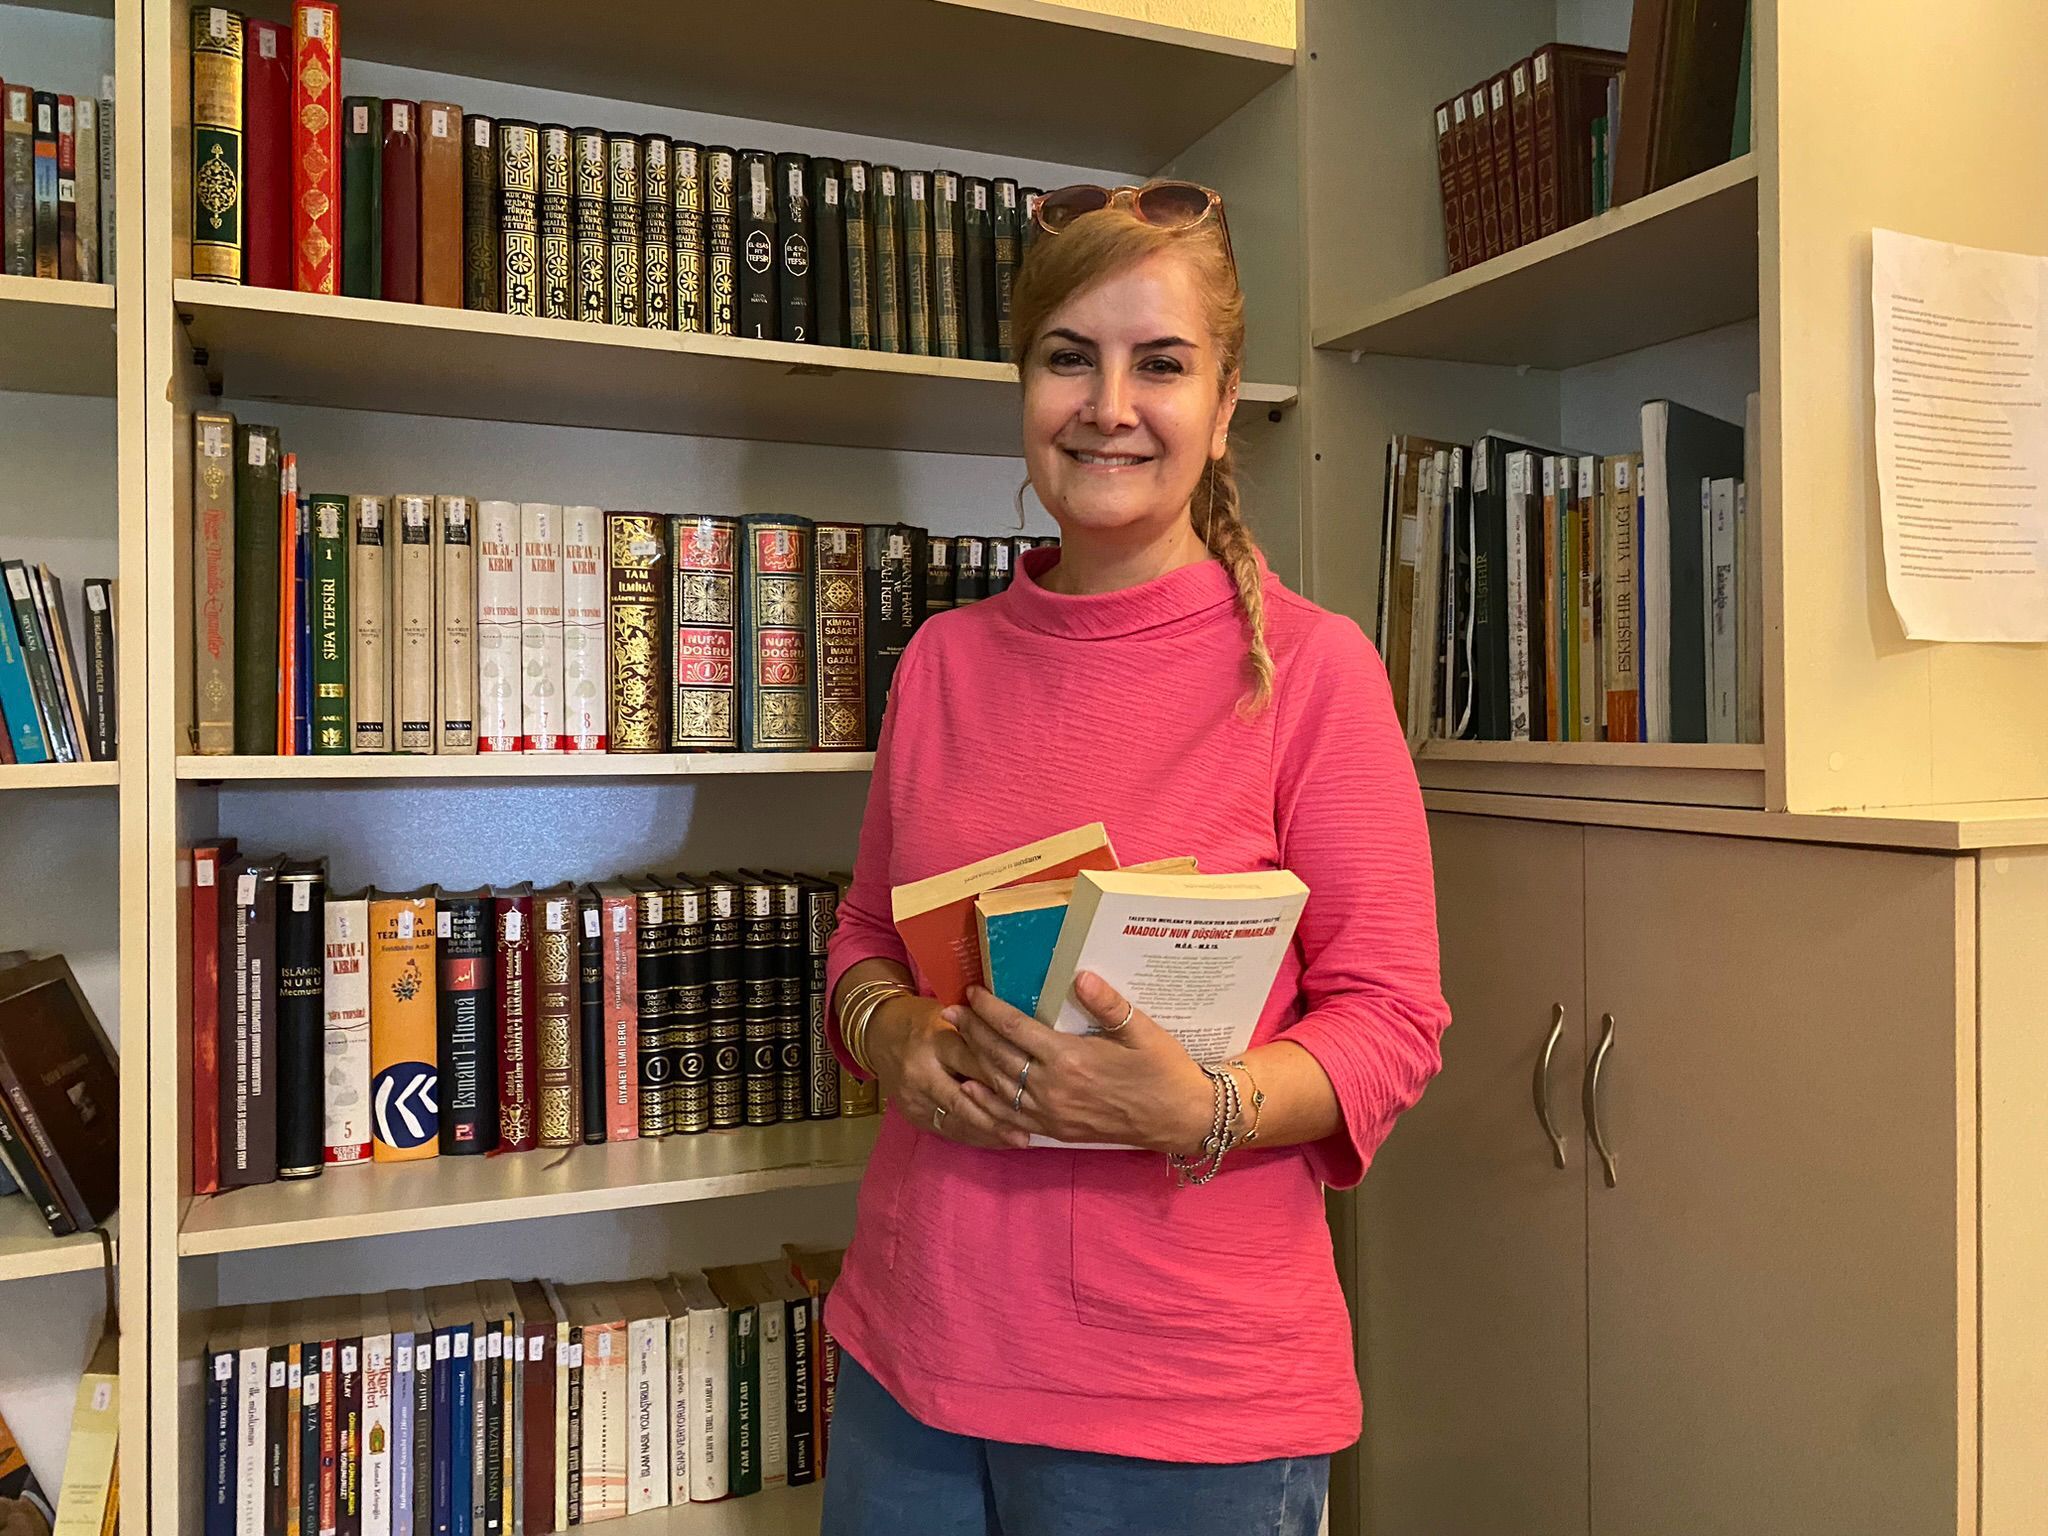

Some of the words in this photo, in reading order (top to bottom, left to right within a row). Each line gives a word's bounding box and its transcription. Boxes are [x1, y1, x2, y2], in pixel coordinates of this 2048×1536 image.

[515, 286, 526, 300] 2
[553, 290, 564, 303] 3
[588, 294, 598, 307] 4
[623, 297, 634, 309] 5
[654, 296, 663, 308] 6
[687, 304, 695, 316] 7
[722, 308, 731, 320] 8
[755, 323, 763, 339] 1
[794, 325, 806, 341] 2
[325, 549, 334, 560] 1
[413, 551, 419, 559] 3
[624, 569, 649, 580] TAM
[894, 580, 902, 593] ve
[321, 578, 336, 629] TEFSİRİ
[881, 586, 894, 621] KERİM
[688, 634, 726, 645] NUR'A
[1617, 593, 1632, 673] ESKİŞEHİR
[323, 630, 339, 661] ŞİFA
[765, 637, 802, 647] NUR'A
[683, 645, 729, 656] DOĞRU
[762, 648, 805, 658] DOĞRU
[704, 663, 712, 678] 1
[782, 666, 790, 679] 2
[584, 712, 591, 729] 8
[1122, 925, 1191, 938] ANADOLU'NUN
[1191, 927, 1233, 941] DÜŞÜNCE
[283, 977, 321, 987] NURU
[725, 1051, 733, 1066] 3
[763, 1050, 771, 1064] 4
[790, 1049, 798, 1062] 5
[655, 1061, 662, 1076] 1
[688, 1058, 698, 1072] 2
[344, 1121, 351, 1139] 5
[824, 1346, 835, 1383] AHMET
[795, 1359, 808, 1413] GÜLZAR-I
[639, 1381, 652, 1433] YOZLAŞTIRILDI
[738, 1381, 749, 1419] KİTABI
[675, 1399, 686, 1447] VERİYORUM
[705, 1415, 714, 1433] TEMEL
[740, 1422, 749, 1447] DUA
[639, 1433, 651, 1454] NASIL
[639, 1454, 651, 1478] İSLAM
[676, 1450, 686, 1476] CEVAP
[740, 1450, 750, 1476] TAM
